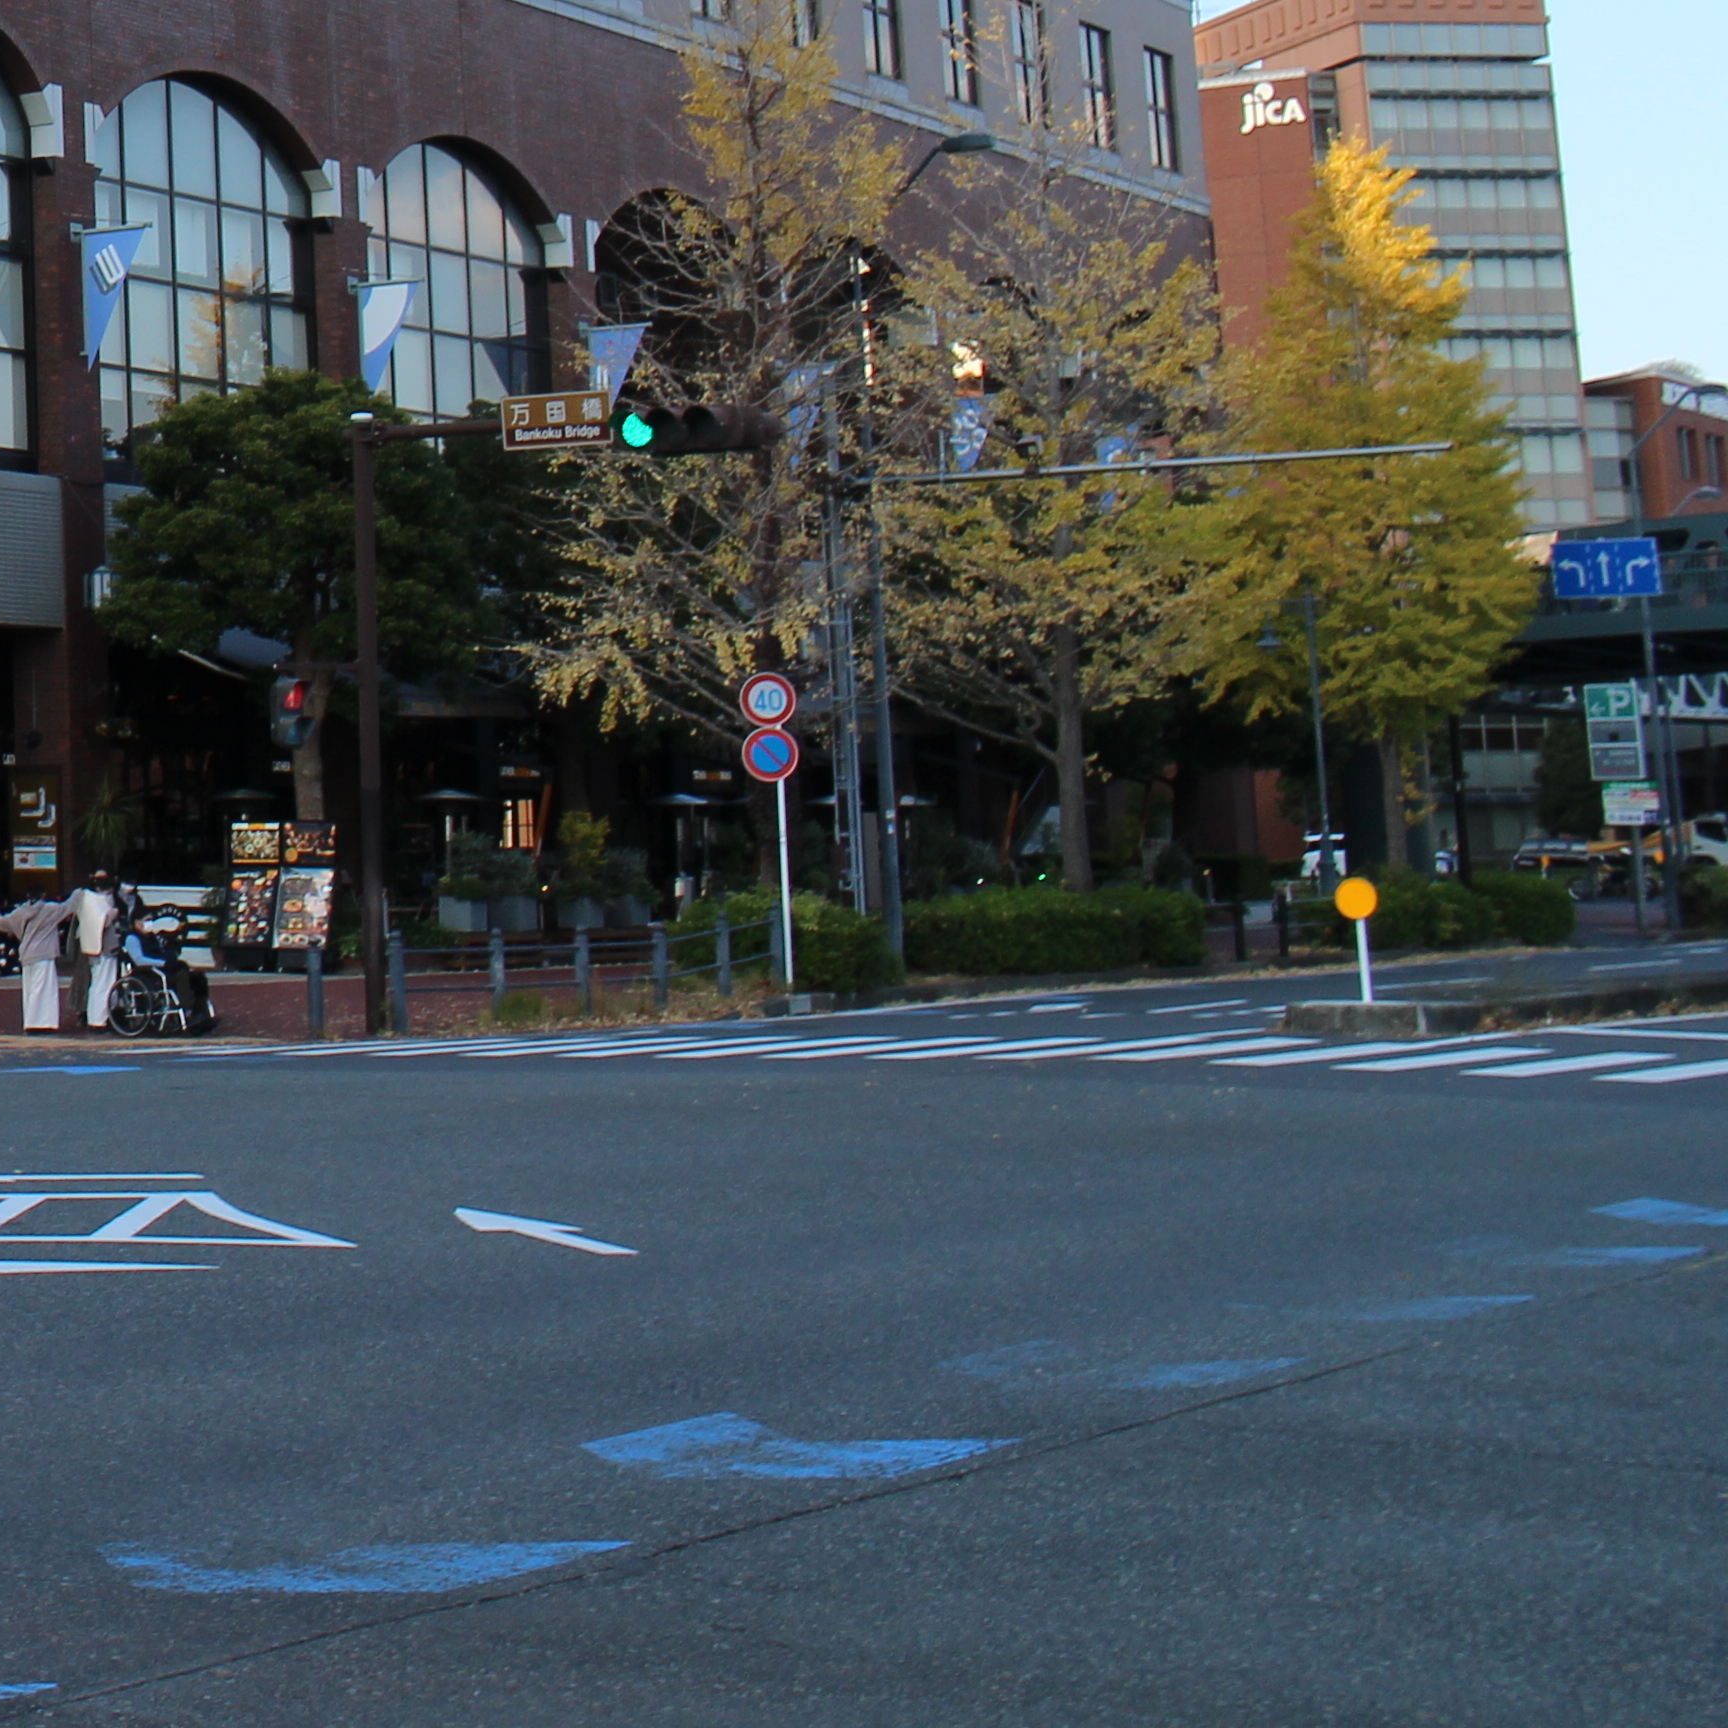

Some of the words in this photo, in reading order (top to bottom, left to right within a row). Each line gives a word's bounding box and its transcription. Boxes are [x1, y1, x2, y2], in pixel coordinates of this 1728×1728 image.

[509, 397, 603, 426] 万国橋
[514, 426, 563, 442] Bankoku
[564, 424, 601, 439] Bridge
[754, 688, 782, 711] 40
